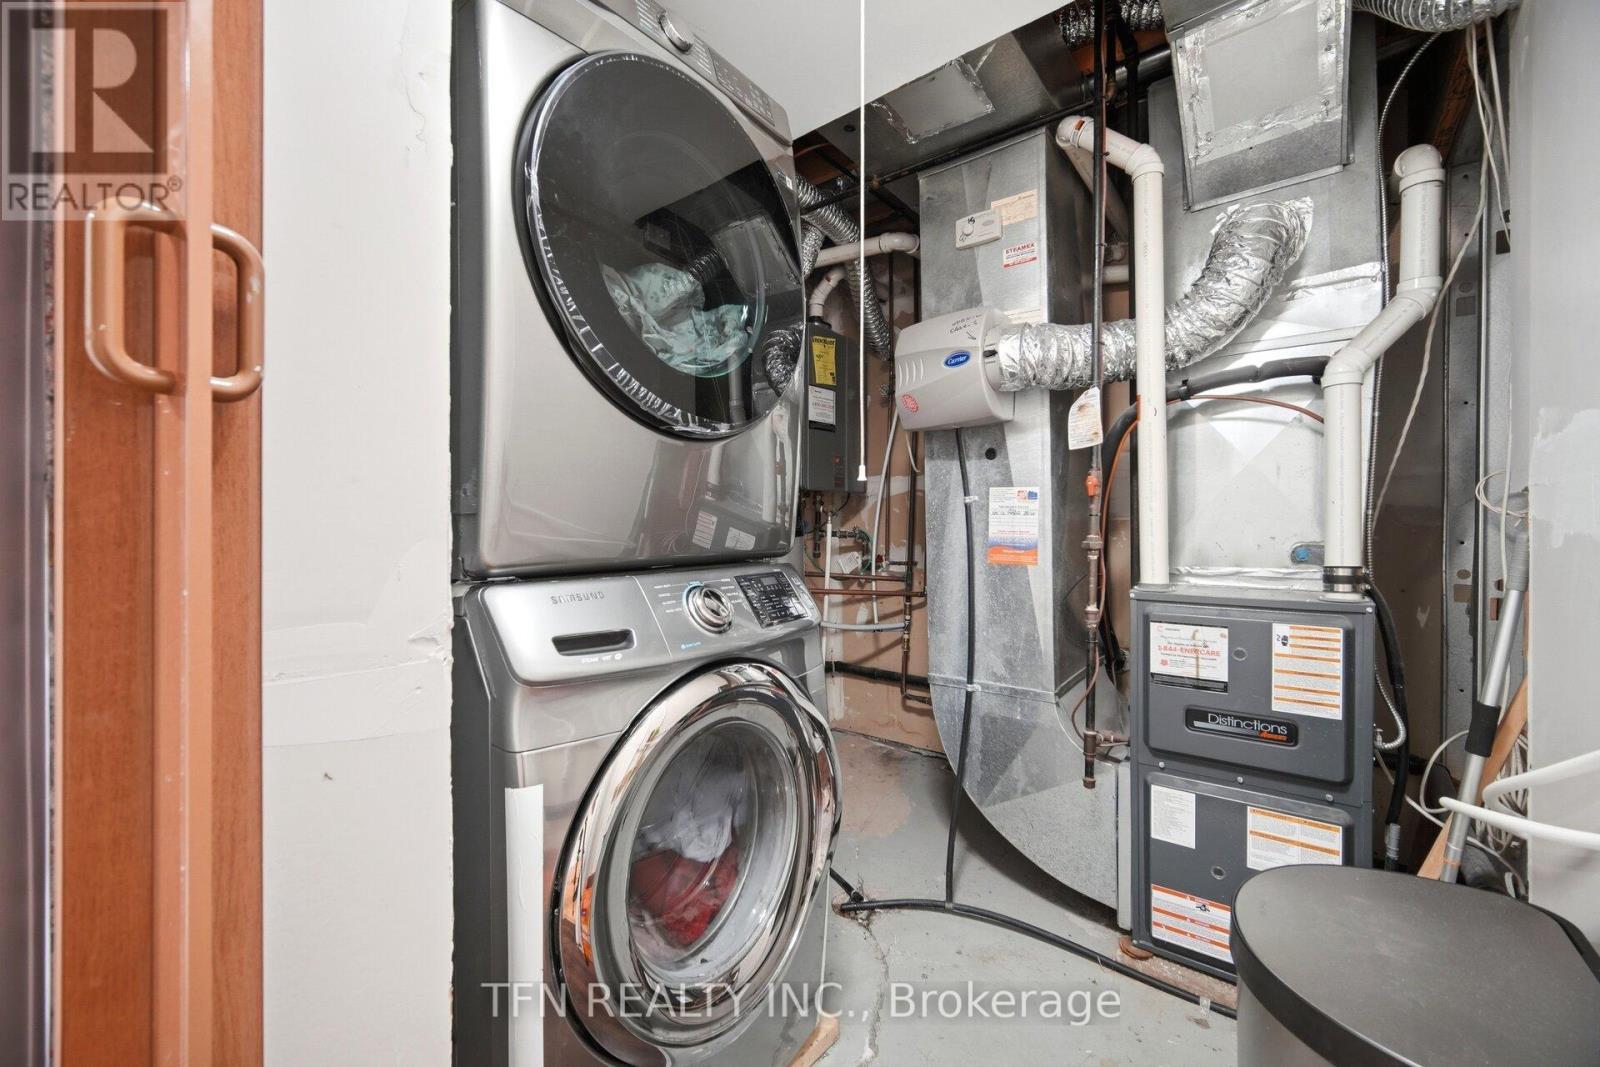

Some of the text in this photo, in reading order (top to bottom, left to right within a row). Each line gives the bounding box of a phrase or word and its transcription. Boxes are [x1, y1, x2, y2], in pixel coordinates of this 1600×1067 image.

[947, 354, 967, 365] Carrier
[550, 591, 605, 605] SAMSUNG
[1207, 713, 1288, 735] Distinctions
